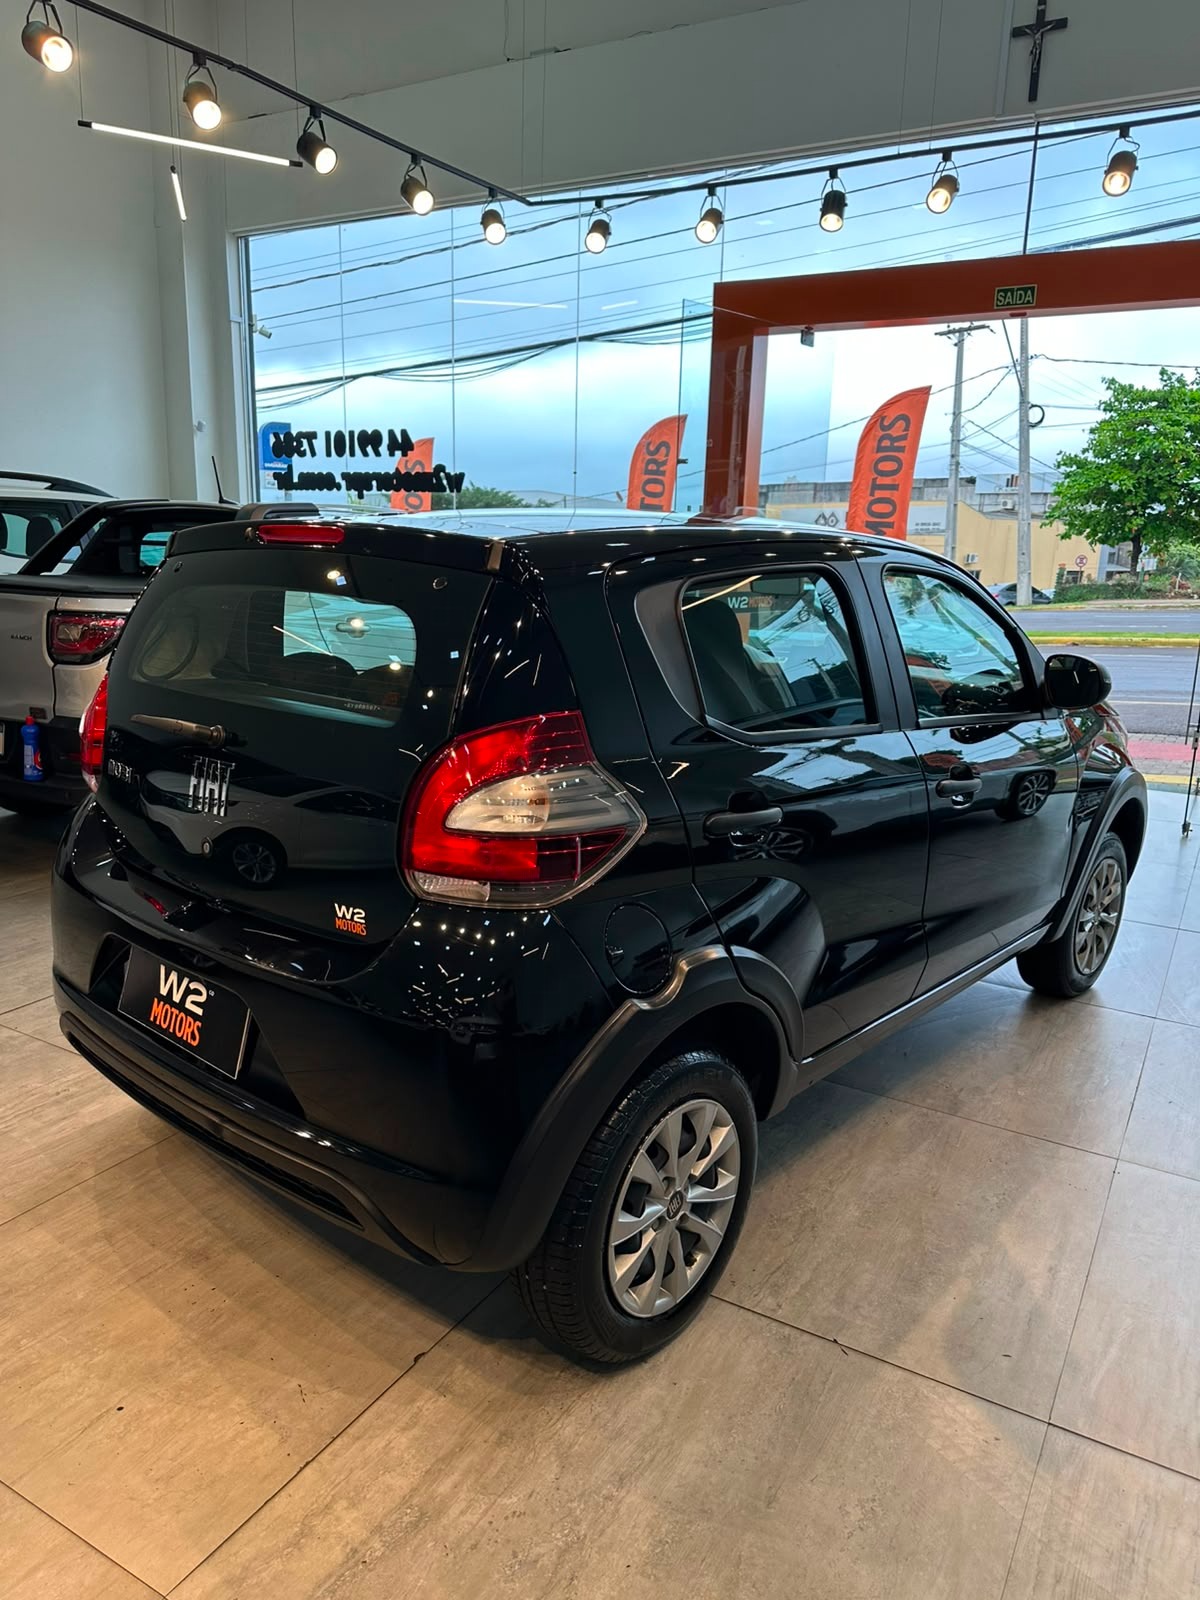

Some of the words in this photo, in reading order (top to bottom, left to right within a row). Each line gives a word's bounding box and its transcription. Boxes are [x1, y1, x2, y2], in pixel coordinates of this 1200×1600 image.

[997, 288, 1033, 305] SAÍDA
[639, 440, 671, 512] TORS
[727, 596, 749, 608] W2
[334, 902, 366, 923] W2
[335, 917, 367, 936] MOTORS
[149, 996, 202, 1047] MOTORS
